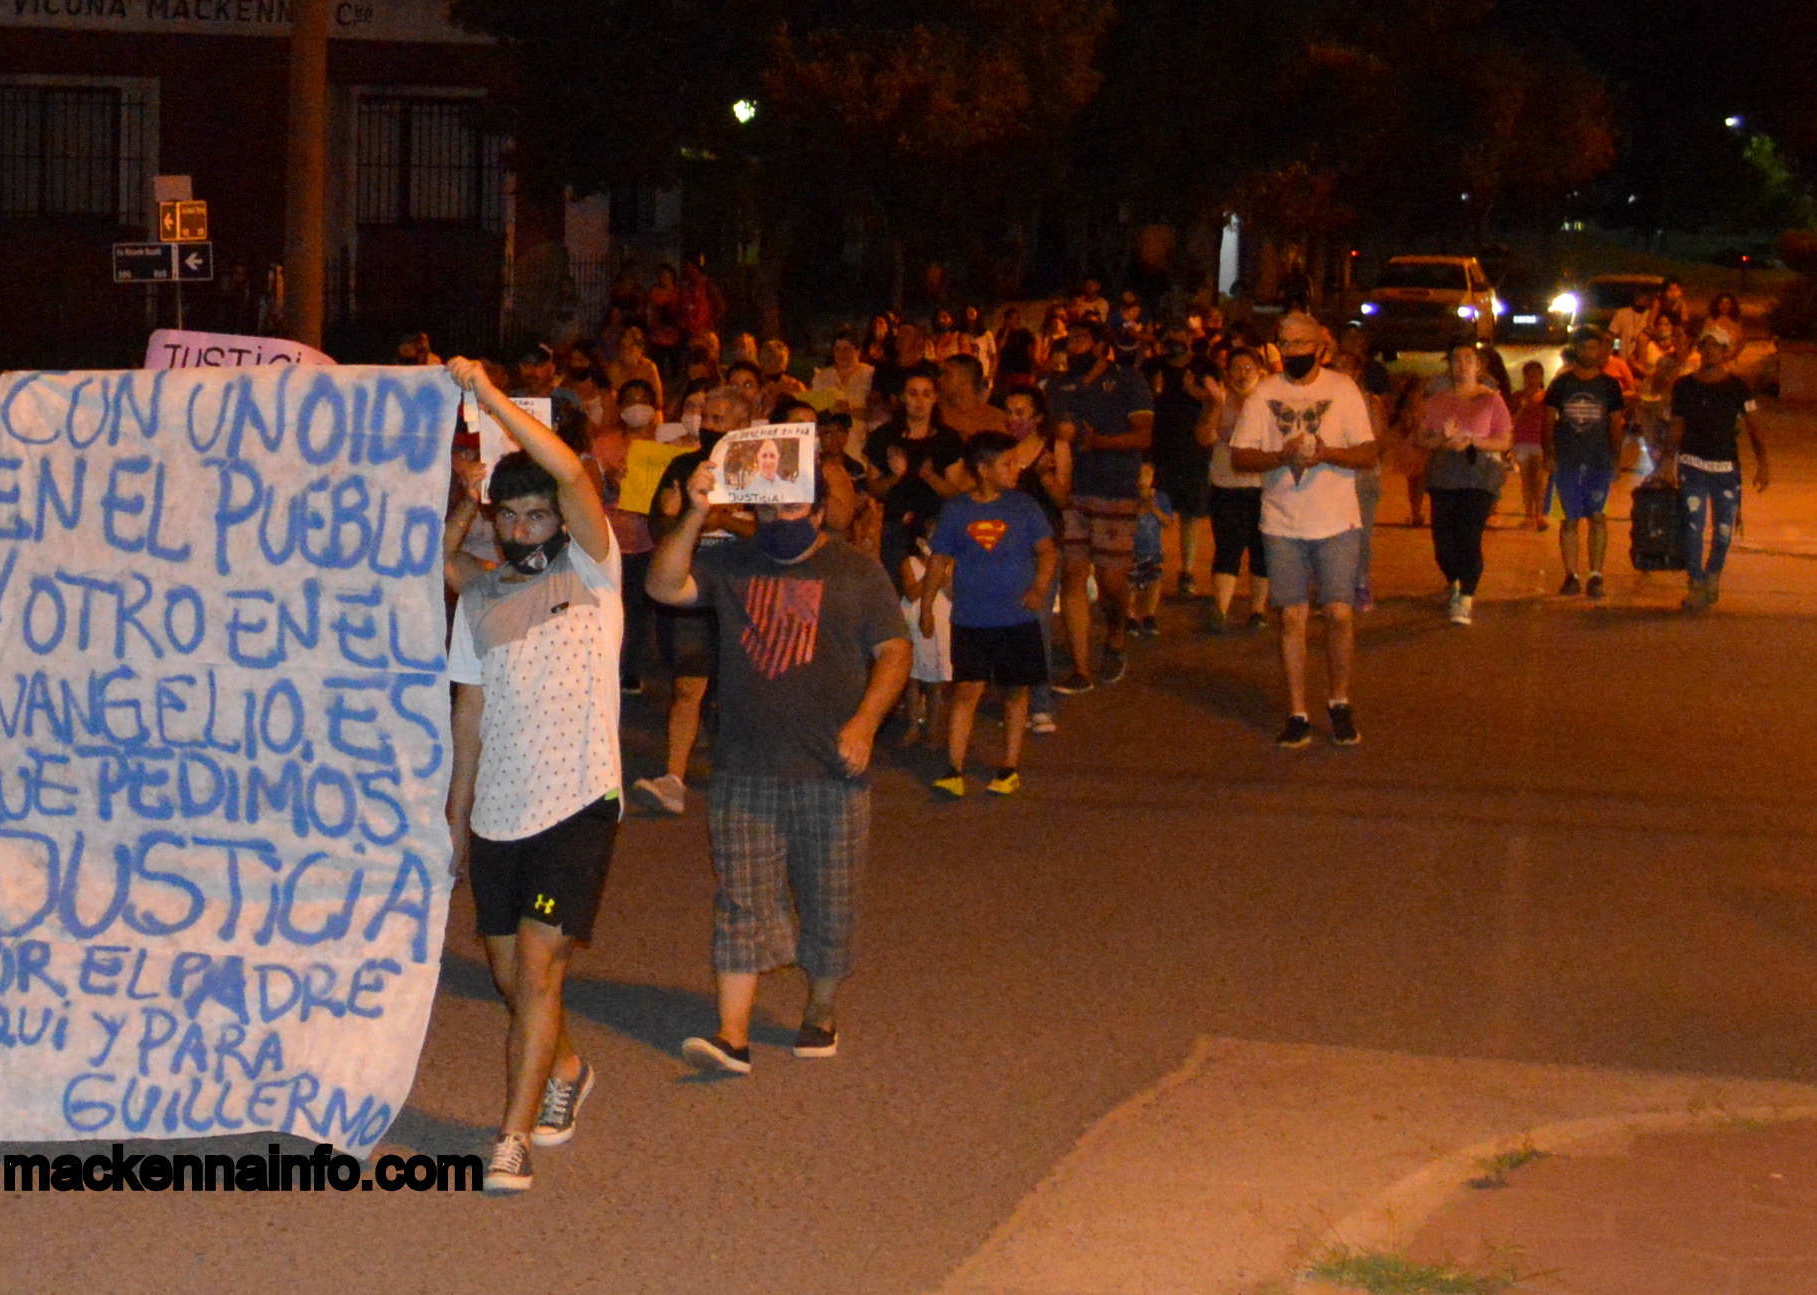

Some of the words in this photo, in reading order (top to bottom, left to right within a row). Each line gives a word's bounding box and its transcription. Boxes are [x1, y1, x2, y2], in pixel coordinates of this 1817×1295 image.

[1, 370, 168, 449] CON
[185, 376, 292, 459] UN
[298, 376, 443, 473] OIDO
[101, 456, 192, 562] EL
[202, 456, 443, 578] PUEBLO
[23, 570, 207, 660] OTRO
[224, 578, 323, 669] EN
[329, 584, 446, 672] EL
[321, 671, 443, 781] ES
[80, 746, 410, 847] PEDIMOS
[81, 945, 160, 999] EL
[164, 952, 402, 1025] PADRE
[138, 1007, 283, 1081] PARA
[62, 1072, 391, 1147] GUILLERMO
